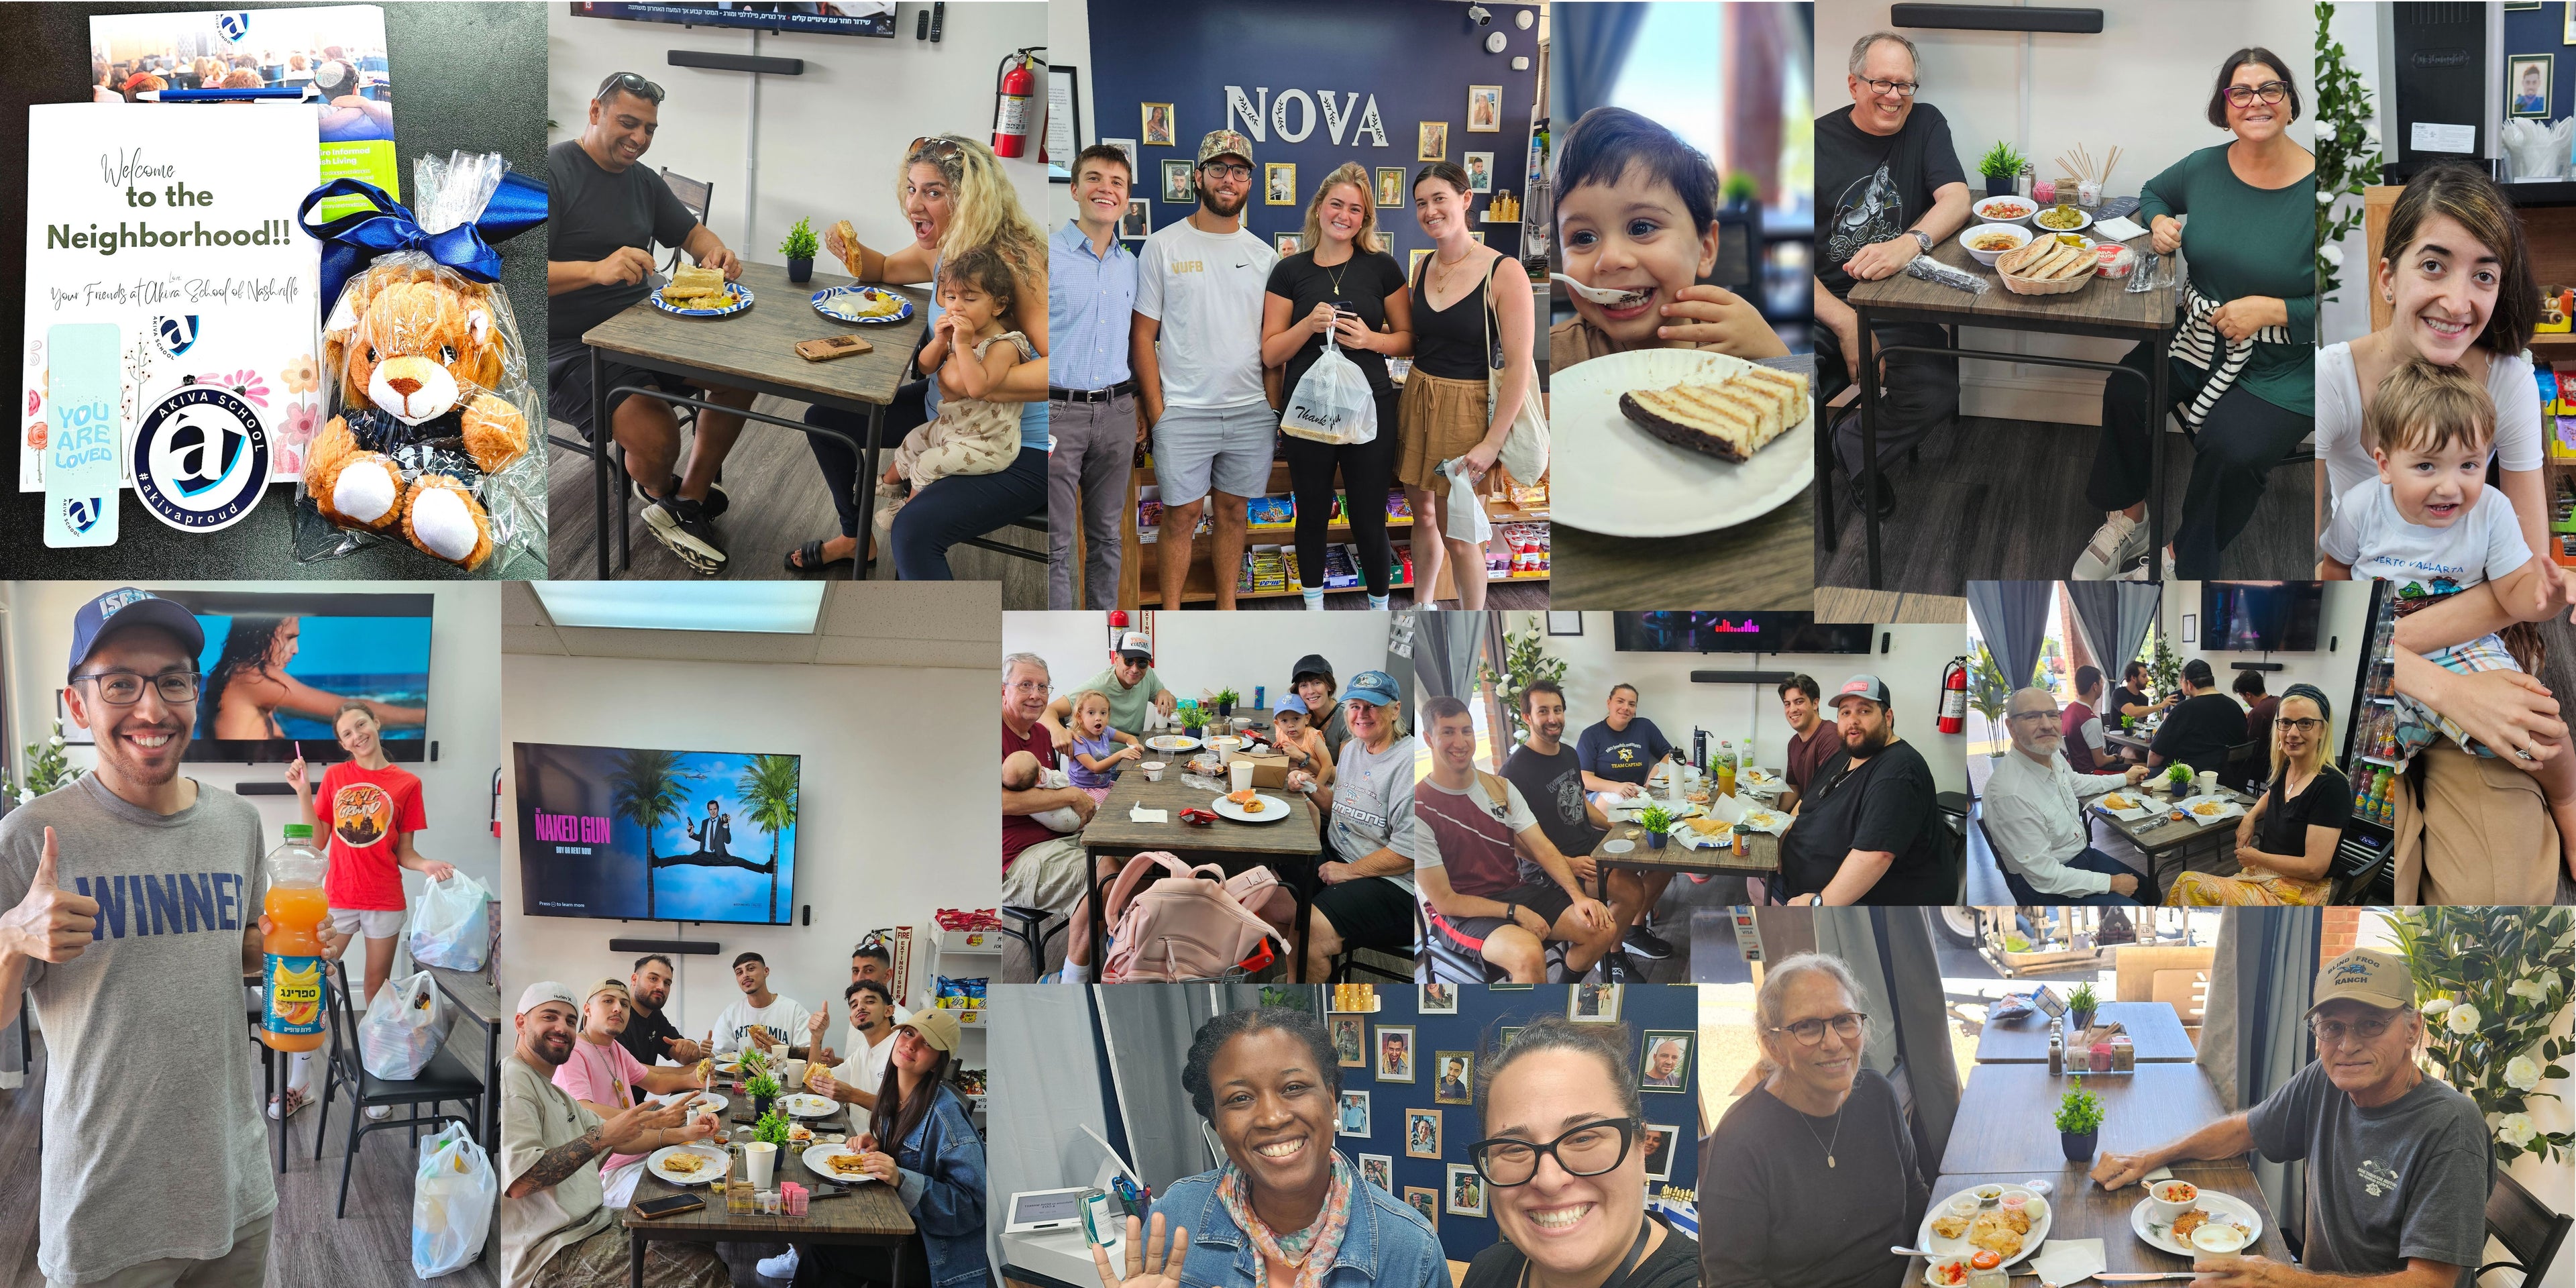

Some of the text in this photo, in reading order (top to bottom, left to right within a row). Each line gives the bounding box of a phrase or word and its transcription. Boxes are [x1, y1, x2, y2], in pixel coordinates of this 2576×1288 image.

[792, 15, 806, 23] קלים
[218, 30, 233, 45] SCHOOL
[1224, 85, 1389, 147] NOVA
[333, 147, 370, 155] Informed
[333, 157, 357, 165] Living
[101, 147, 175, 187] Welcome
[126, 182, 213, 207] to the
[48, 219, 290, 256] Neighborhood!!
[1172, 260, 1203, 274] VUFB
[50, 276, 299, 311] Your Friends at Akiva School of Nashville
[156, 339, 174, 360] SCHOOL
[58, 402, 109, 428] YOU
[158, 392, 264, 452] AKIVA SCHOOL
[1295, 405, 1327, 426] Thank
[57, 424, 110, 451] ARE
[56, 447, 112, 468] LOVED
[139, 472, 238, 525] #akivaproud
[64, 519, 80, 537] SCHOOL
[2409, 561, 2463, 574] VALLARTA
[1332, 800, 1388, 828] MPIONS
[535, 814, 610, 844] NAKED GUN
[582, 847, 592, 855] NOW
[896, 941, 905, 999] EXTINGUISHER
[2328, 956, 2380, 974] BLIND FROG
[2335, 977, 2367, 985] RANCH
[280, 989, 316, 998] ספרינג
[2366, 1171, 2383, 1181] THROUGH
[2383, 1179, 2397, 1188] HISTOR
